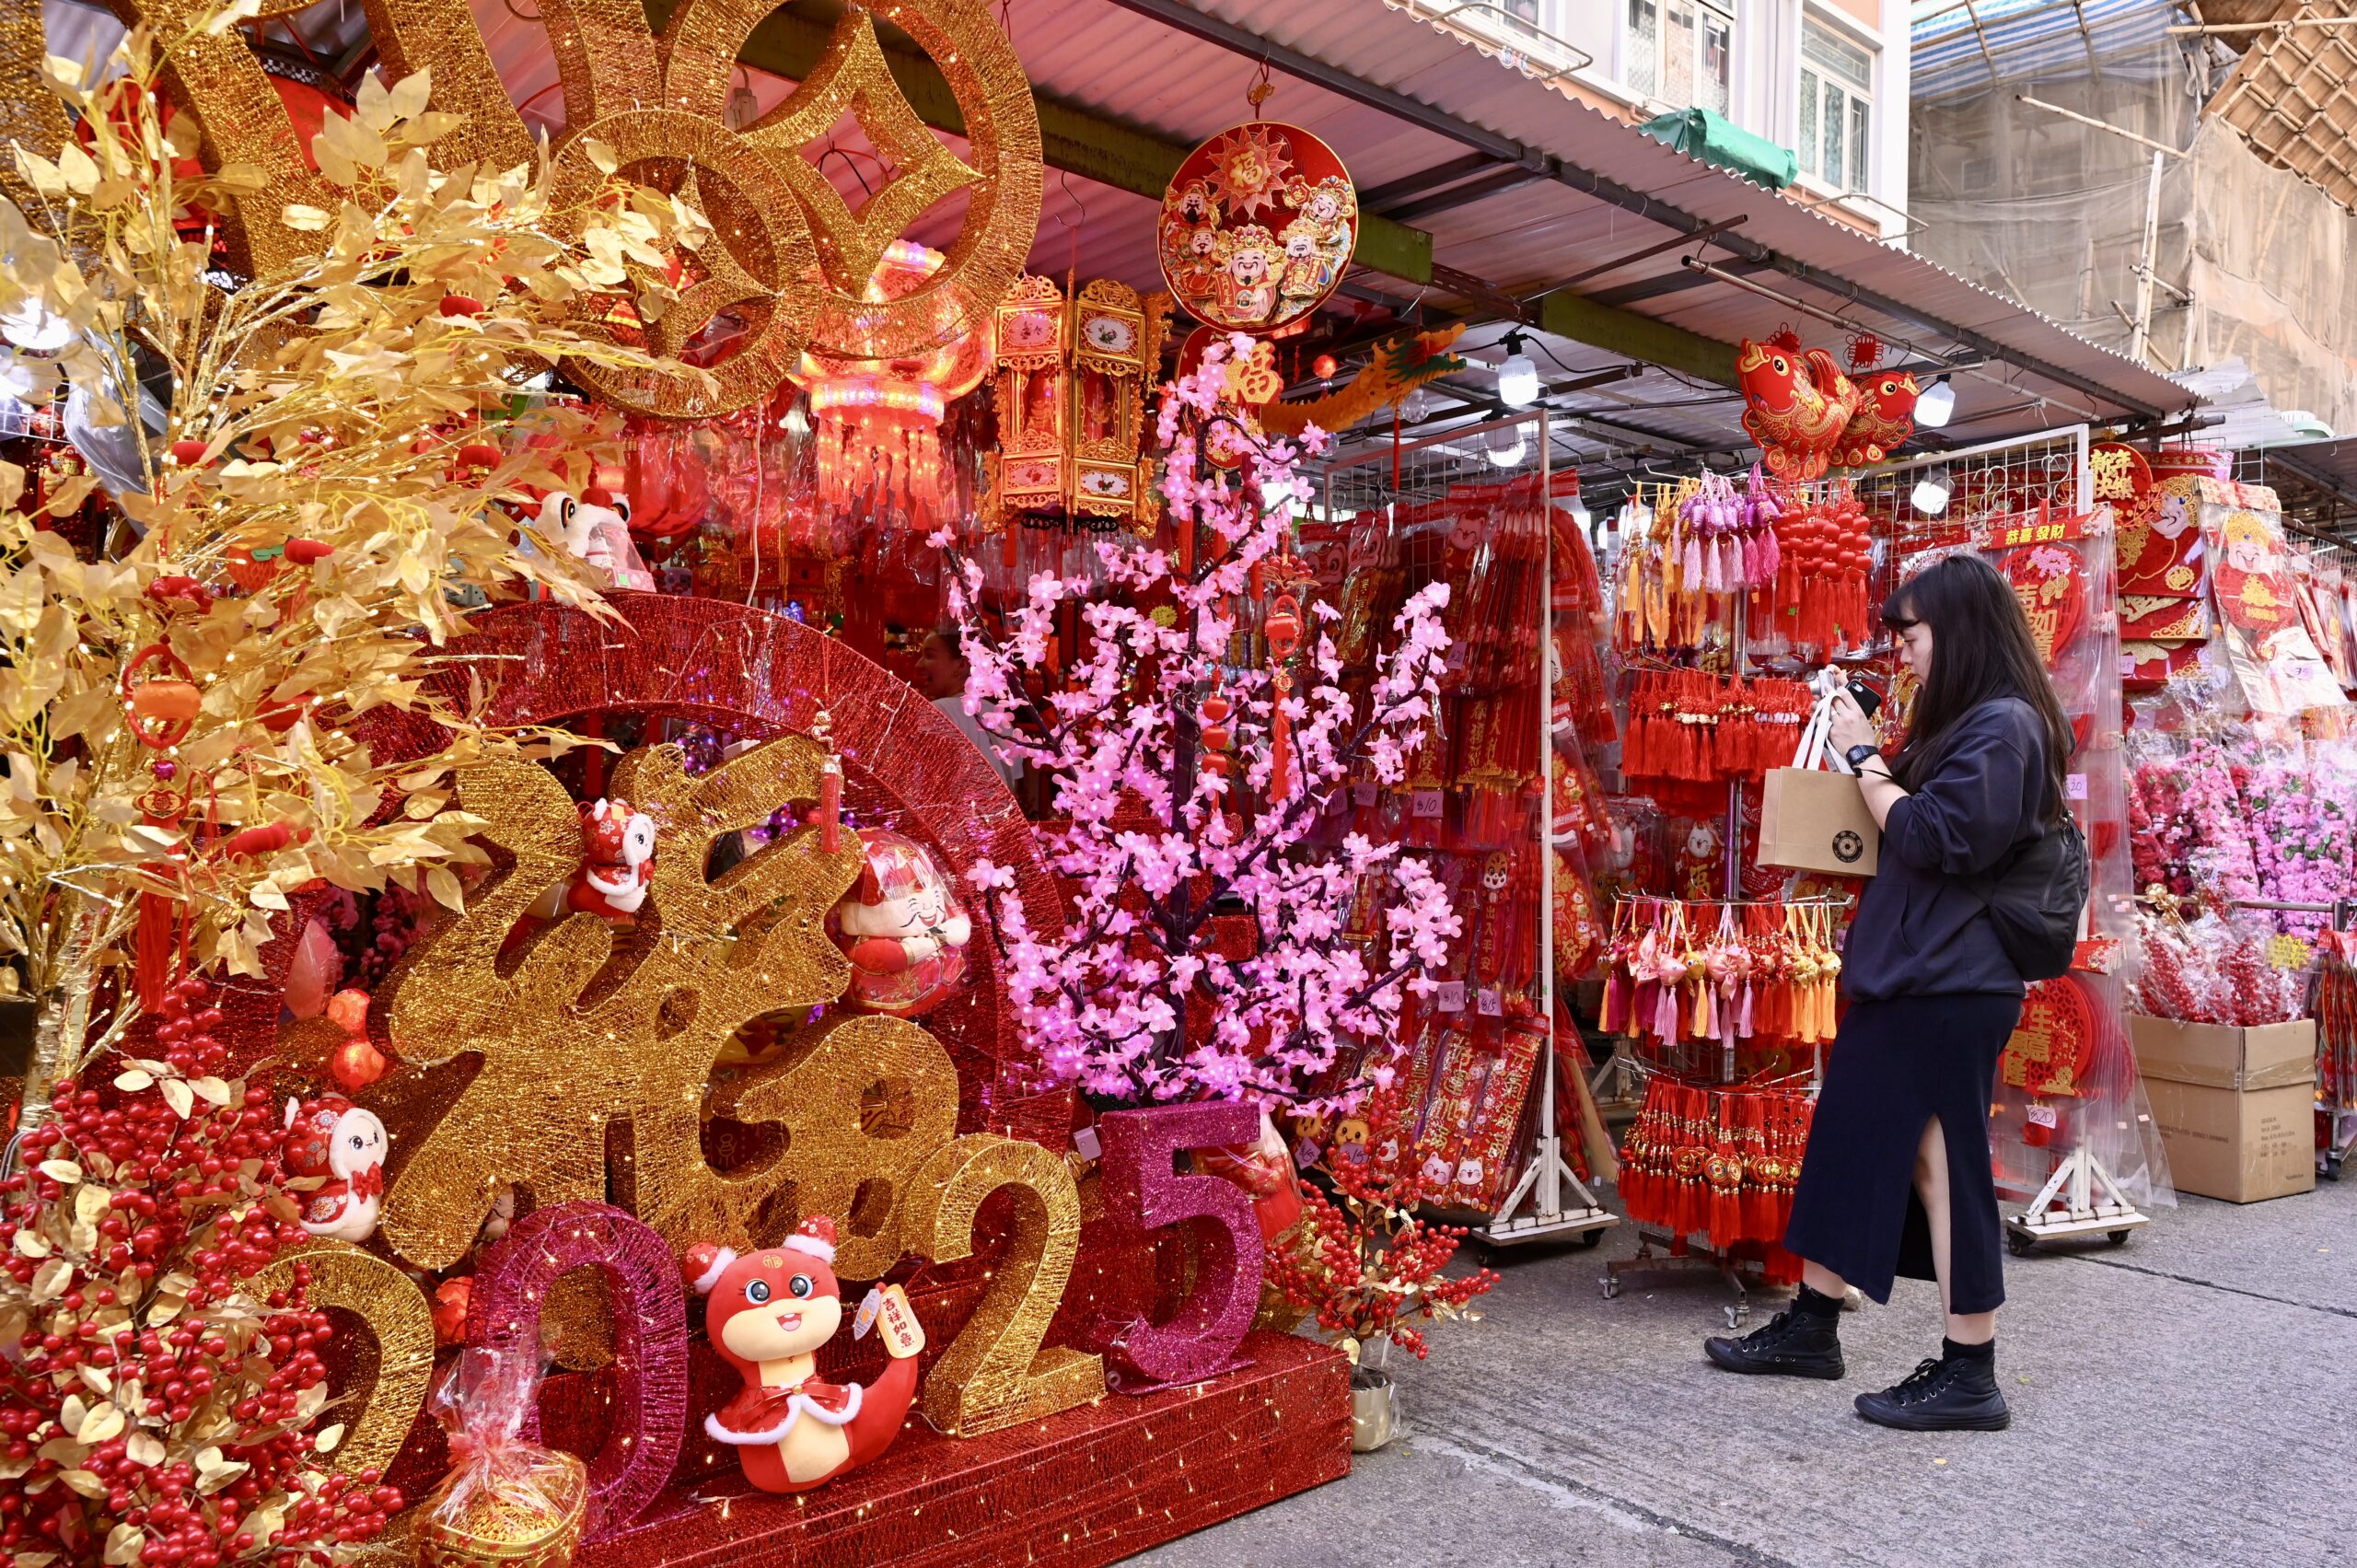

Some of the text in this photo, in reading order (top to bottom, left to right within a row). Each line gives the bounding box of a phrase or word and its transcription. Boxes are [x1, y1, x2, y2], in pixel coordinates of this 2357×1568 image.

[1229, 151, 1263, 188] 福
[1220, 342, 1279, 404] 福
[2089, 449, 2135, 478] 新年
[2093, 475, 2135, 500] 快樂
[2004, 523, 2065, 545] 恭喜發財
[1480, 904, 1496, 970] 出入平安
[882, 1296, 915, 1348] 吉祥如意
